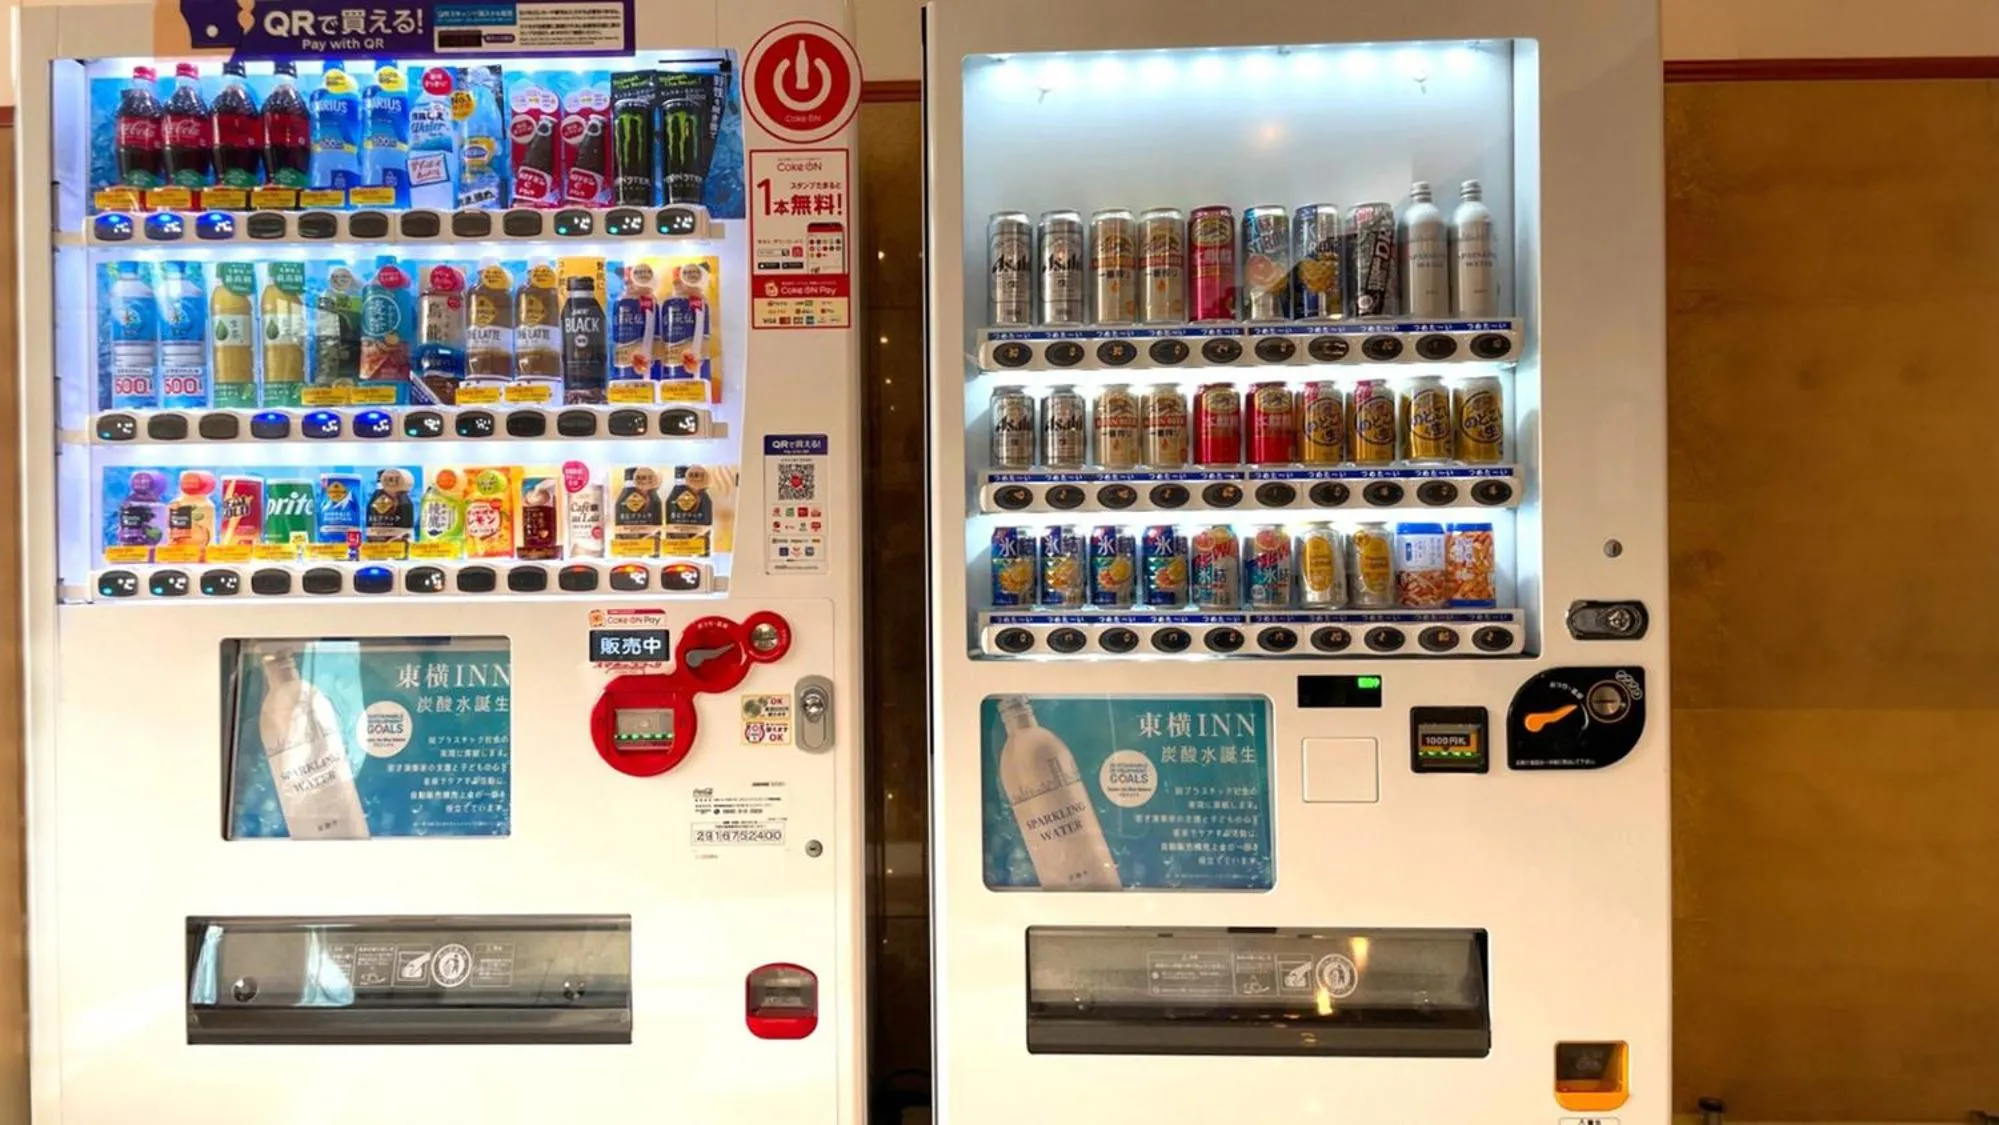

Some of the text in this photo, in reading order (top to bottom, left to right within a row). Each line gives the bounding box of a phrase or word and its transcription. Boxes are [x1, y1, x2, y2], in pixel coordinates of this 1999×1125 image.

[263, 9, 424, 37] QRで買える!
[302, 37, 385, 50] Pay with QR
[776, 162, 822, 172] Coke ON
[757, 178, 842, 216] 1本無料!
[564, 317, 601, 333] BLACK
[266, 491, 315, 517] prite
[607, 616, 661, 626] Coke ON Pay
[600, 636, 662, 655] 販売中
[396, 662, 511, 689] 東横INN
[416, 695, 509, 713] 炭酸水誕生
[770, 697, 783, 705] OK
[366, 723, 404, 735] GOALS
[1136, 712, 1256, 738] 東横INN
[769, 733, 784, 742] OK
[1160, 746, 1257, 764] 炭酸水誕生
[1109, 774, 1149, 784] GOALS
[1025, 802, 1087, 831] SPARKLING
[1039, 819, 1084, 842] WATER
